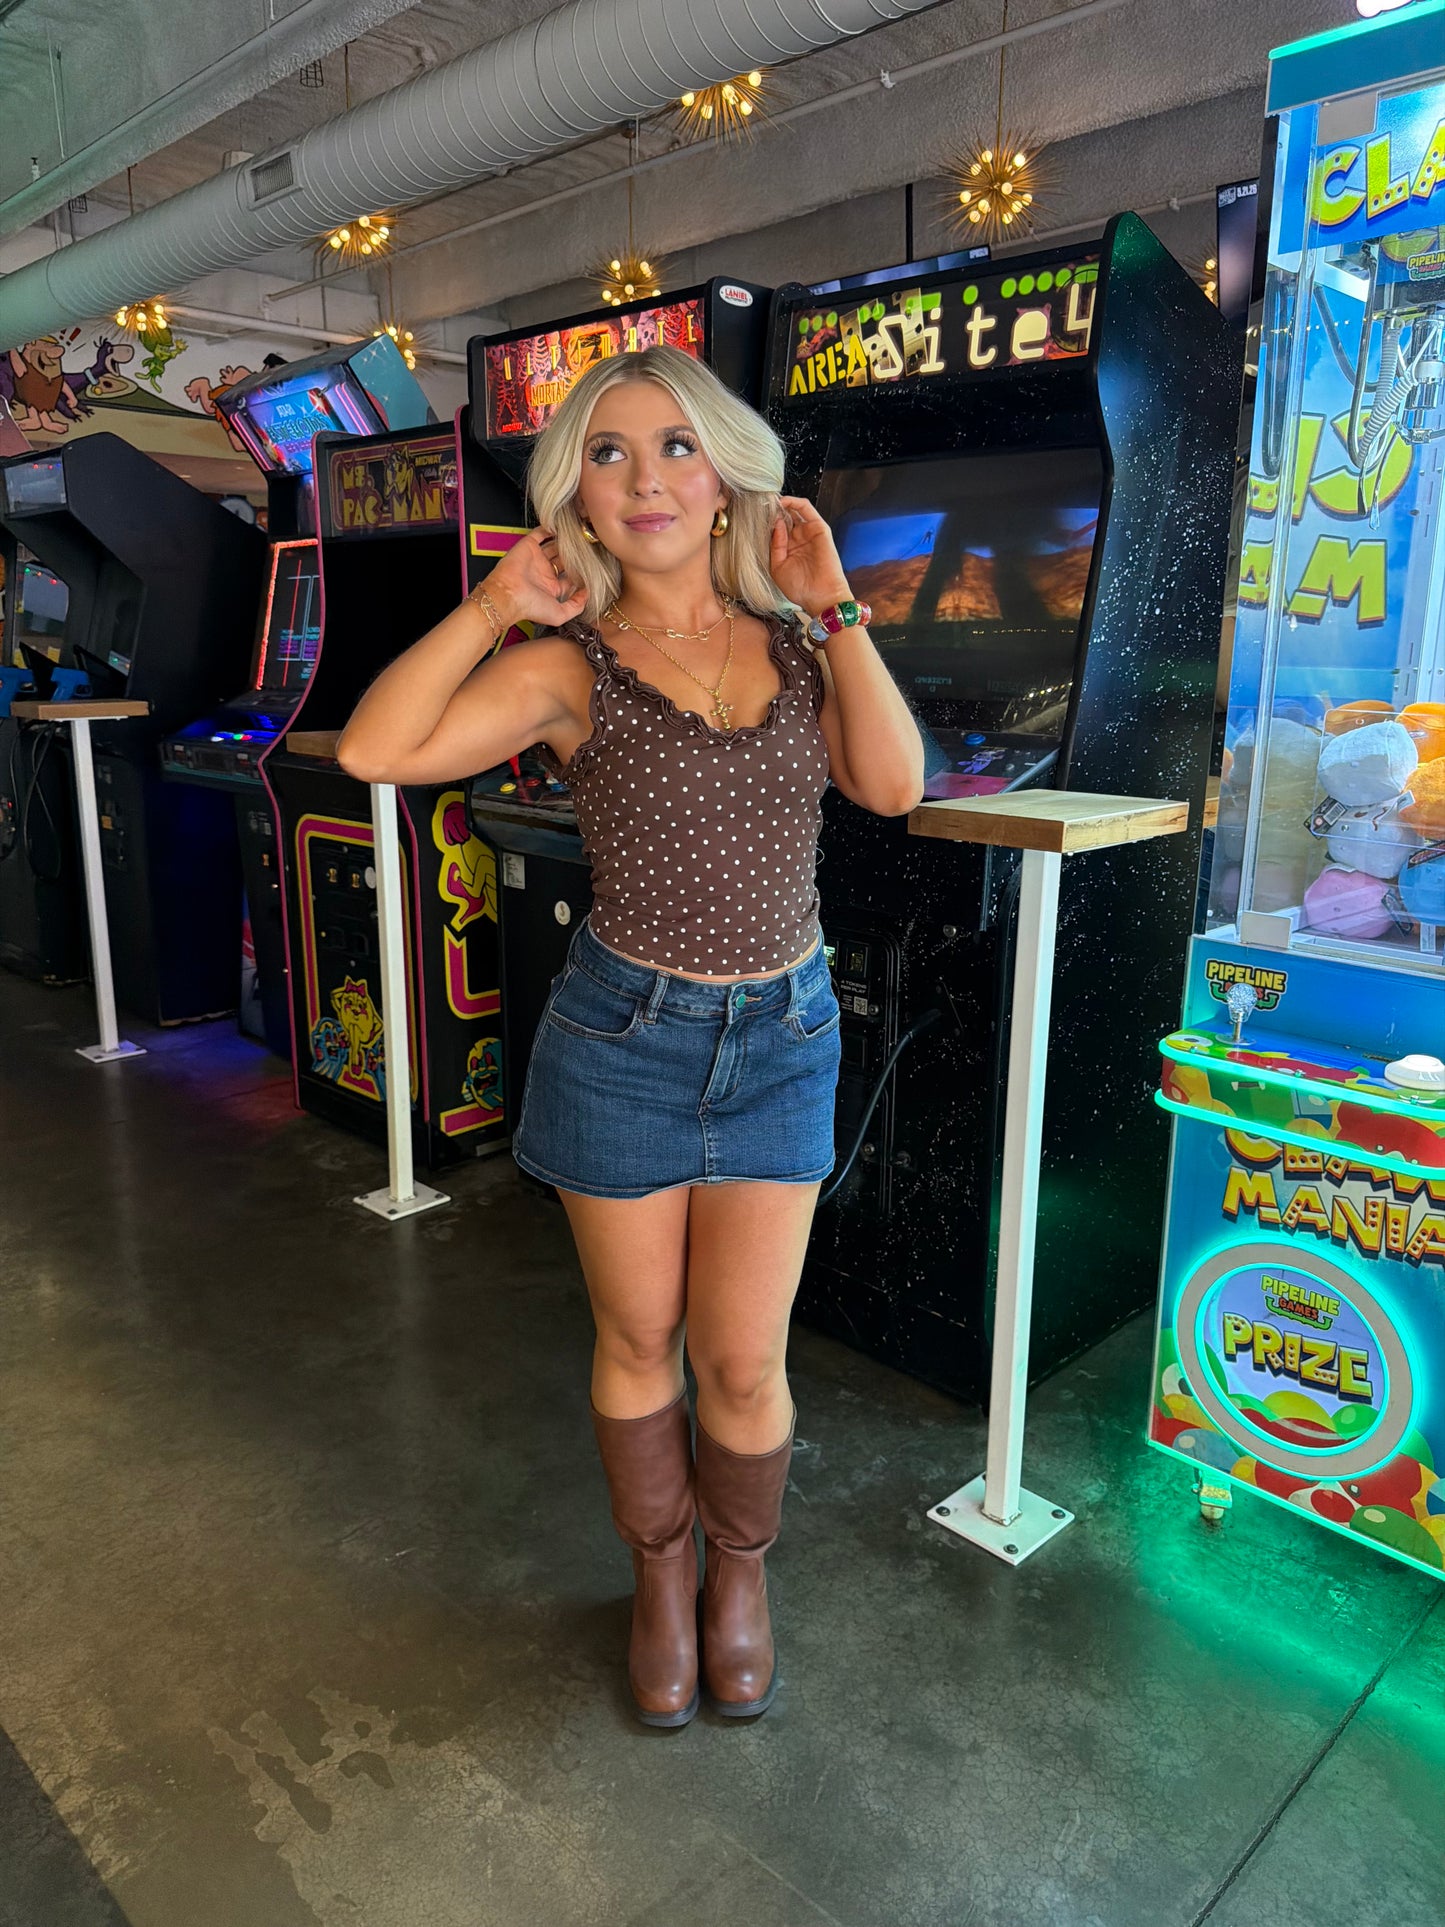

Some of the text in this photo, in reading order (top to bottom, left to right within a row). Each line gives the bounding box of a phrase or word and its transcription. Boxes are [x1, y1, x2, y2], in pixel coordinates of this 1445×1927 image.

[789, 334, 867, 396] AREA
[873, 306, 1048, 380] Site
[342, 487, 441, 527] PAC-MAN
[1207, 961, 1286, 991] PIPELINE
[1222, 1166, 1445, 1260] MANIA
[1262, 1275, 1340, 1316] PIPELINE
[1279, 1297, 1319, 1320] GAMES
[1223, 1312, 1373, 1402] PRIZE
